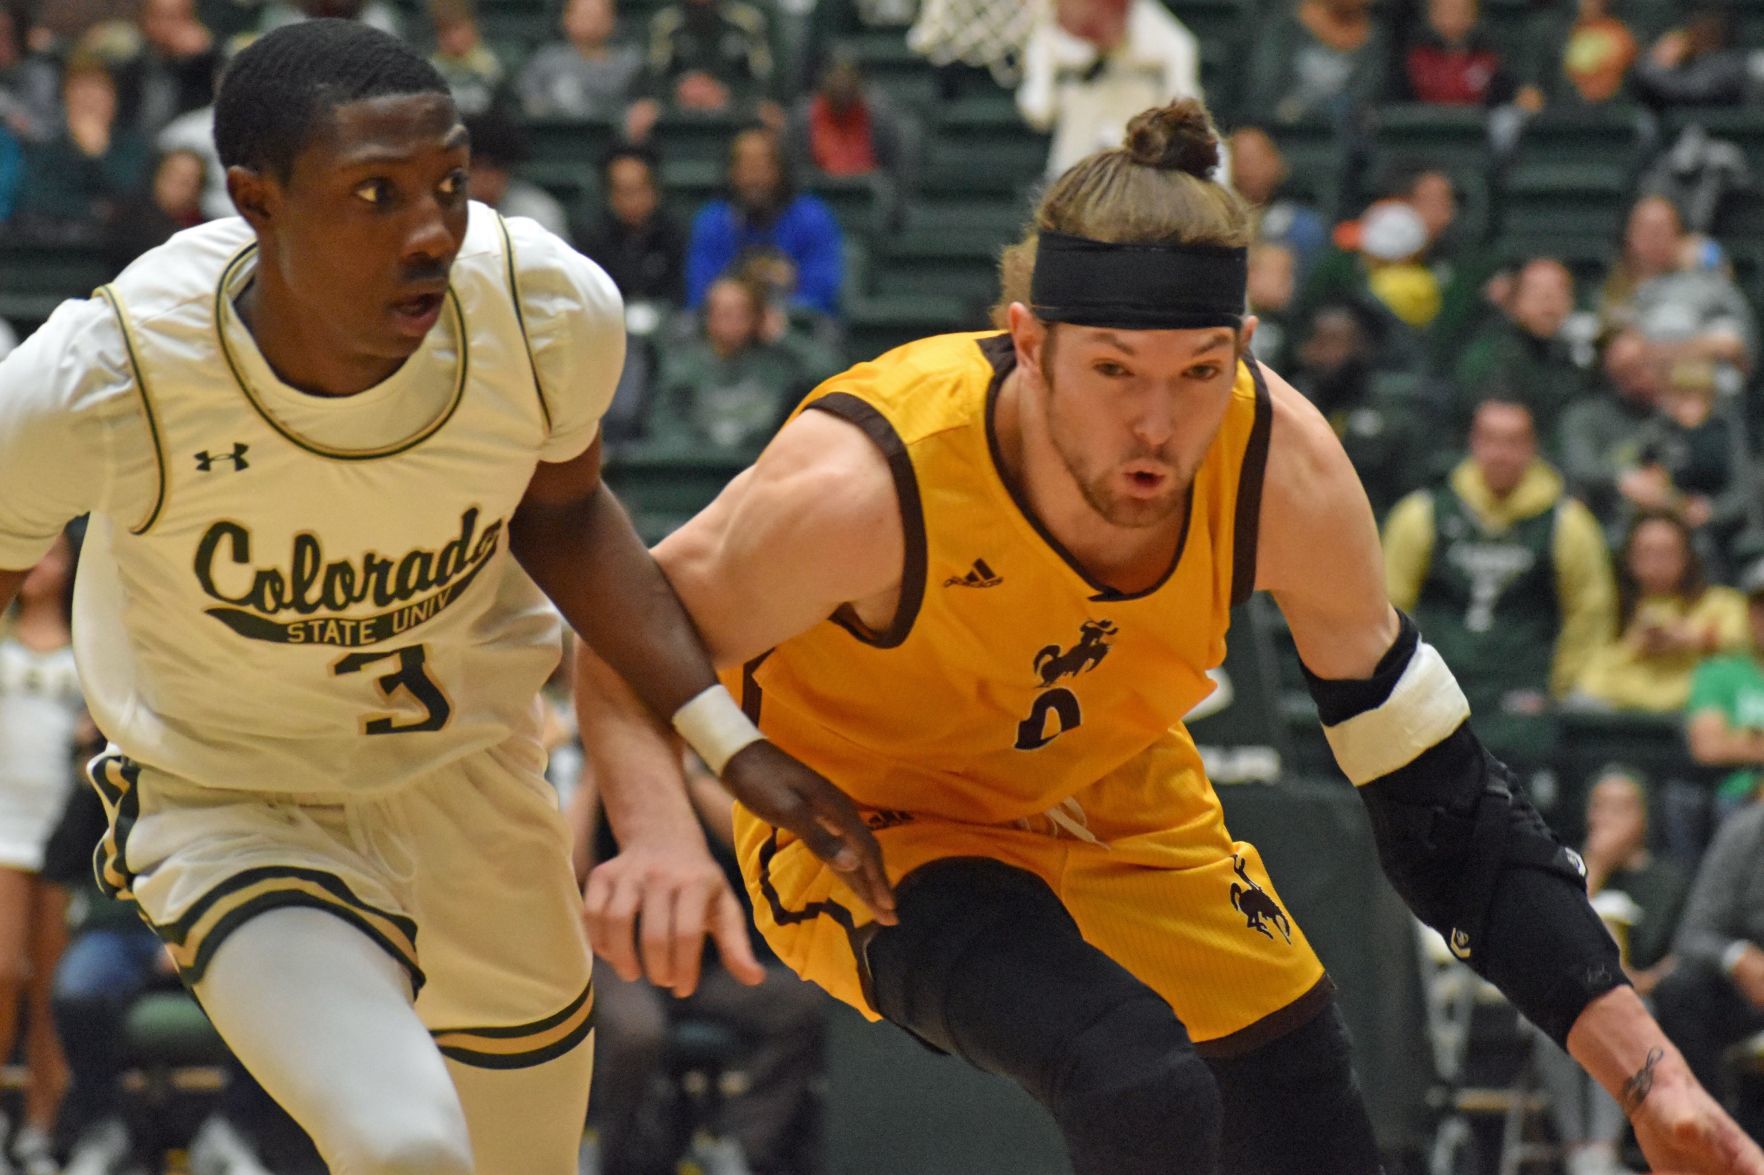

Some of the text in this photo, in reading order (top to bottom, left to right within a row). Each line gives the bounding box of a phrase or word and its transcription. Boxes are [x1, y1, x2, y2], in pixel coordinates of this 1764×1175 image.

[194, 506, 503, 615] Colorado
[287, 618, 378, 646] STATE
[331, 643, 452, 736] 3
